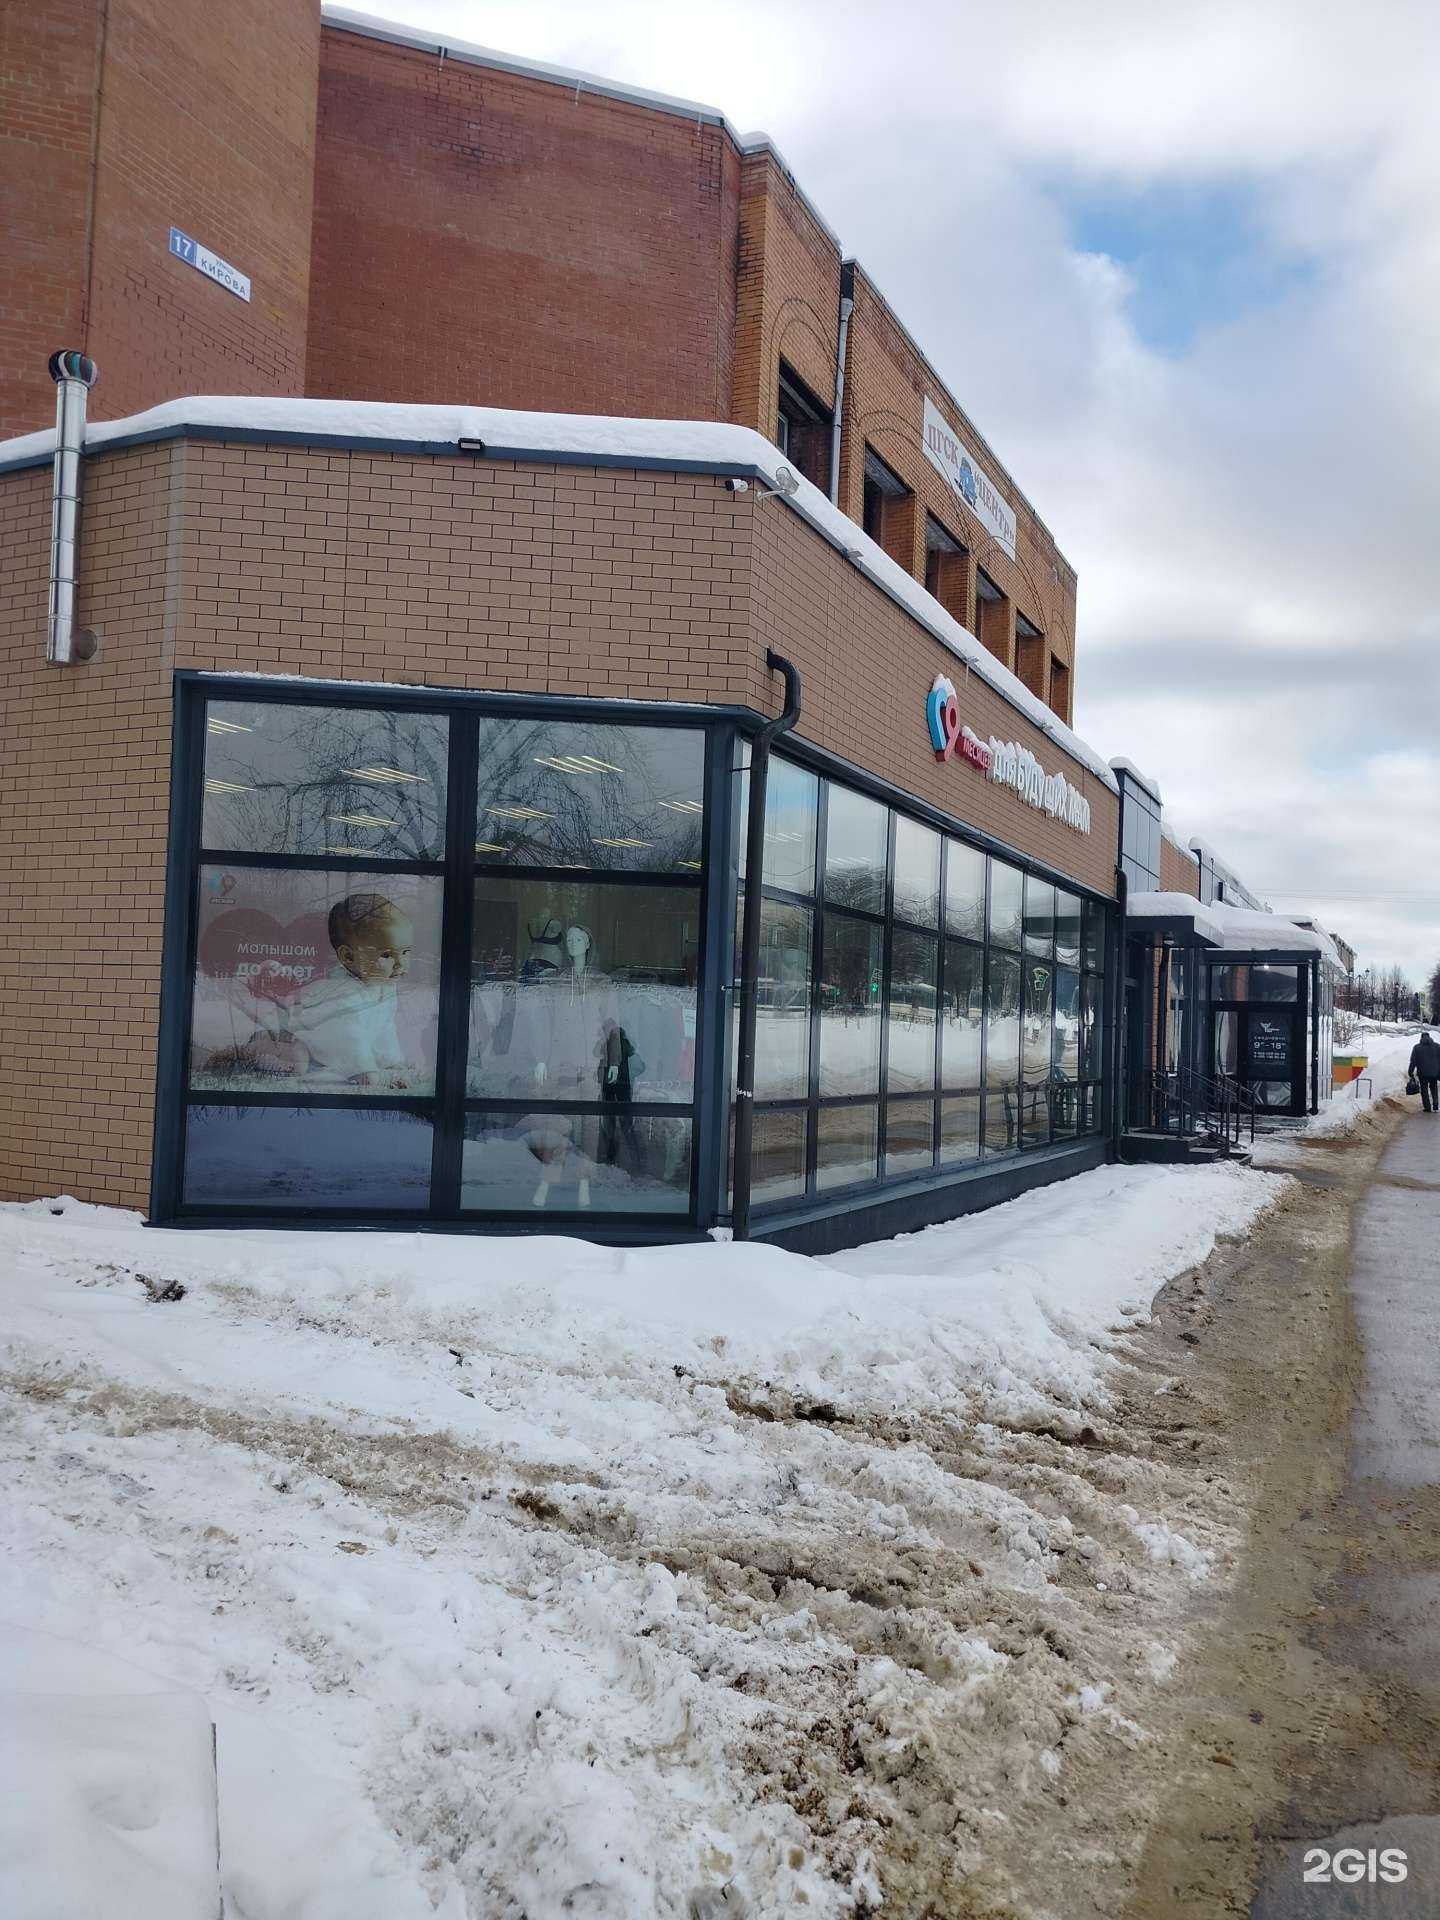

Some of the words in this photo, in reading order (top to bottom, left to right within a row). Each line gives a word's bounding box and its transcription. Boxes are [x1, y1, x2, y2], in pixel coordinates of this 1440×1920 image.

[175, 235, 192, 257] 17
[201, 257, 246, 296] КИРОВА
[237, 943, 317, 957] малышам
[235, 962, 261, 977] до
